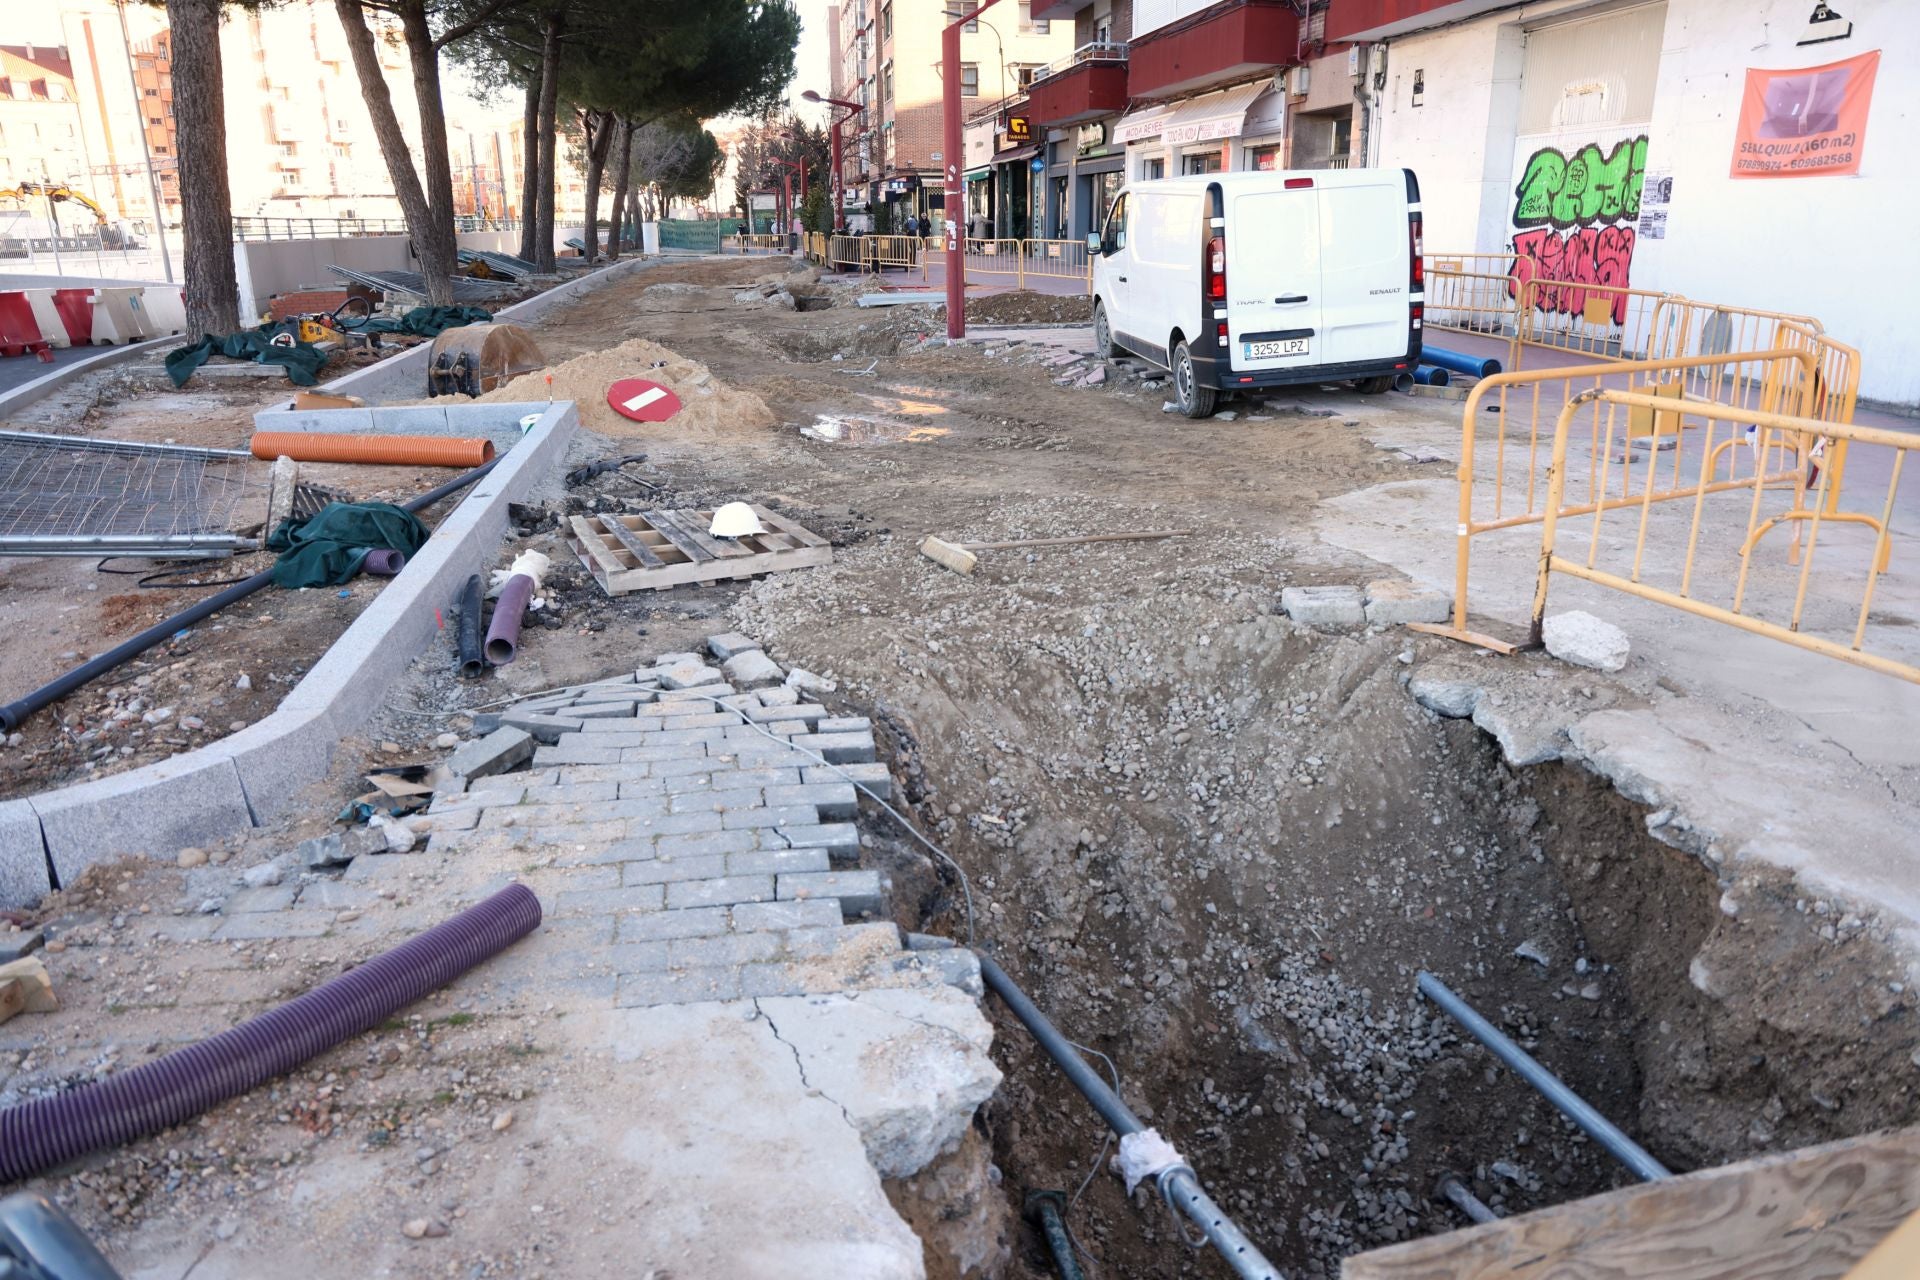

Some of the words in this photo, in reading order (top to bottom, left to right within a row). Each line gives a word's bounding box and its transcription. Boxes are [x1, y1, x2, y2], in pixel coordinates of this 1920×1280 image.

[1369, 287, 1402, 296] RENAULT
[1253, 343, 1280, 356] 3252
[1284, 340, 1304, 353] LPZ
